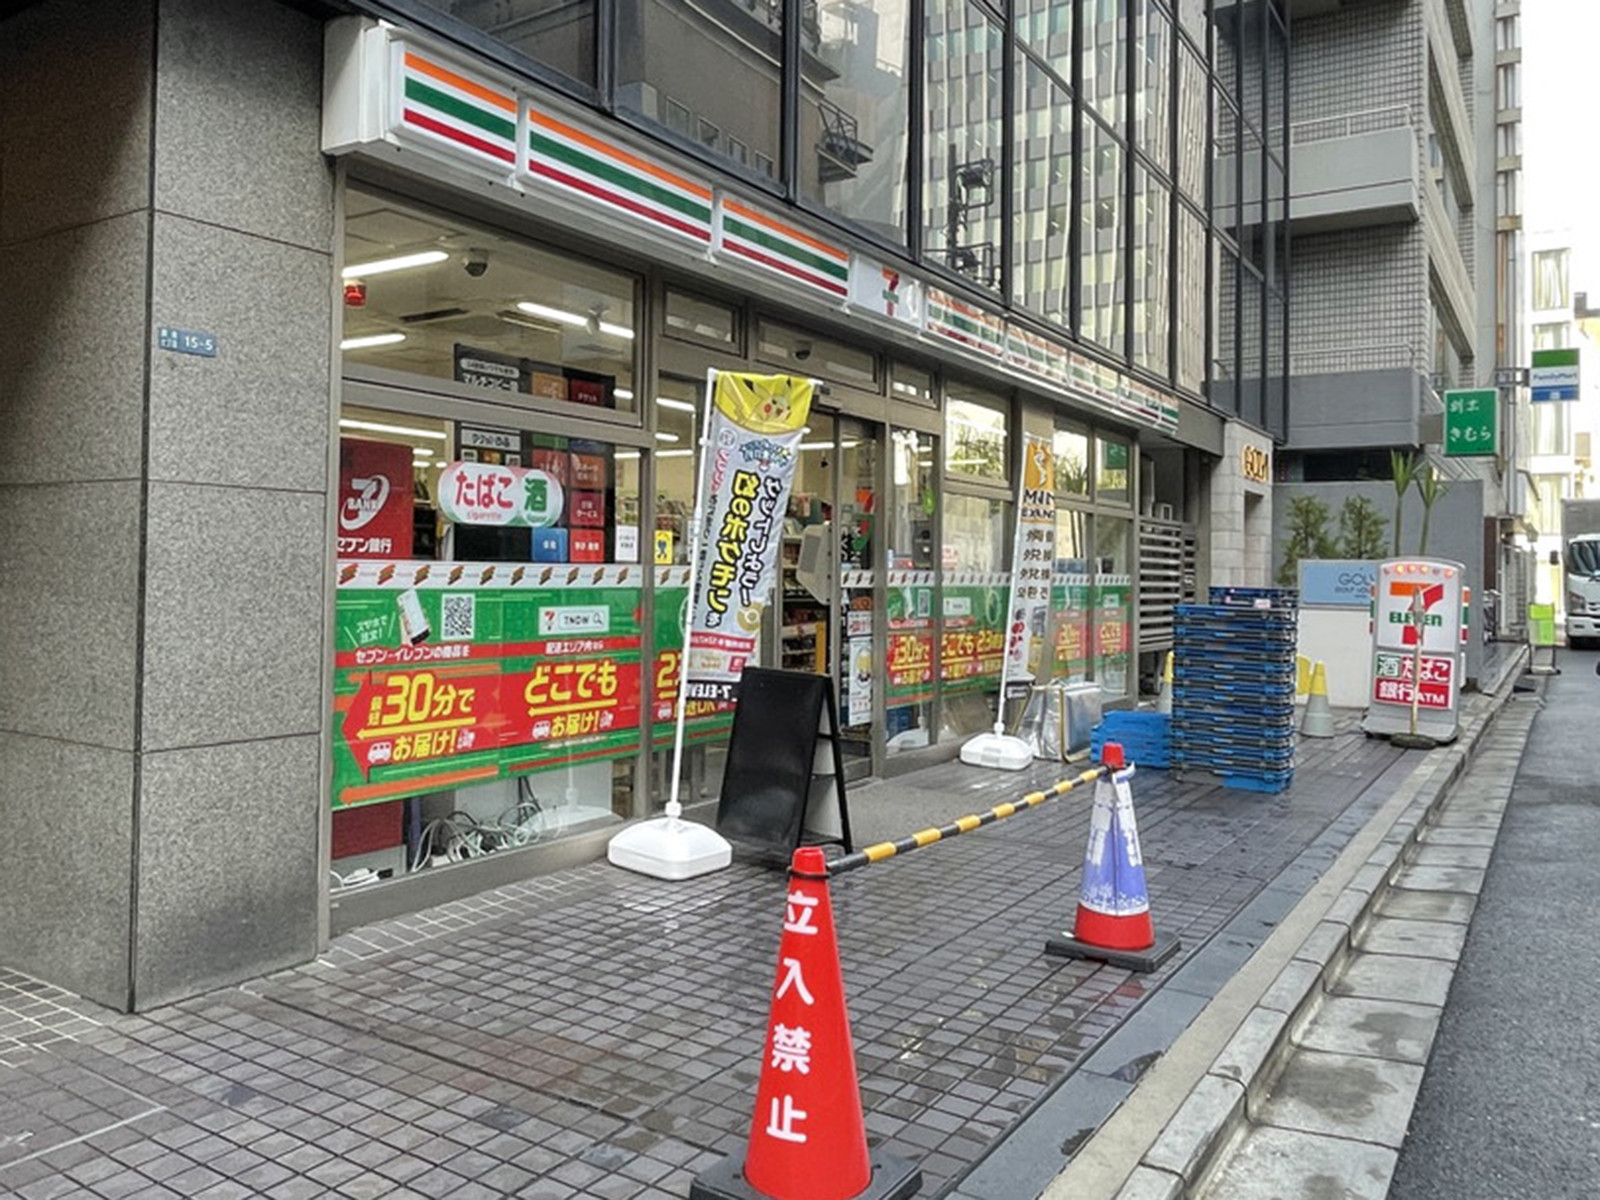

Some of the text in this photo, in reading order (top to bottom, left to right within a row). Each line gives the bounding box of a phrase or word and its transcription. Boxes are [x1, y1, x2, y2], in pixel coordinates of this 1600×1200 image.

[185, 335, 213, 351] 15-5
[456, 471, 548, 512] たばこ 酒
[1379, 656, 1399, 676] 酒
[525, 660, 617, 704] どこでも
[1418, 693, 1446, 704] ATM
[766, 890, 818, 1143] 立入禁止
